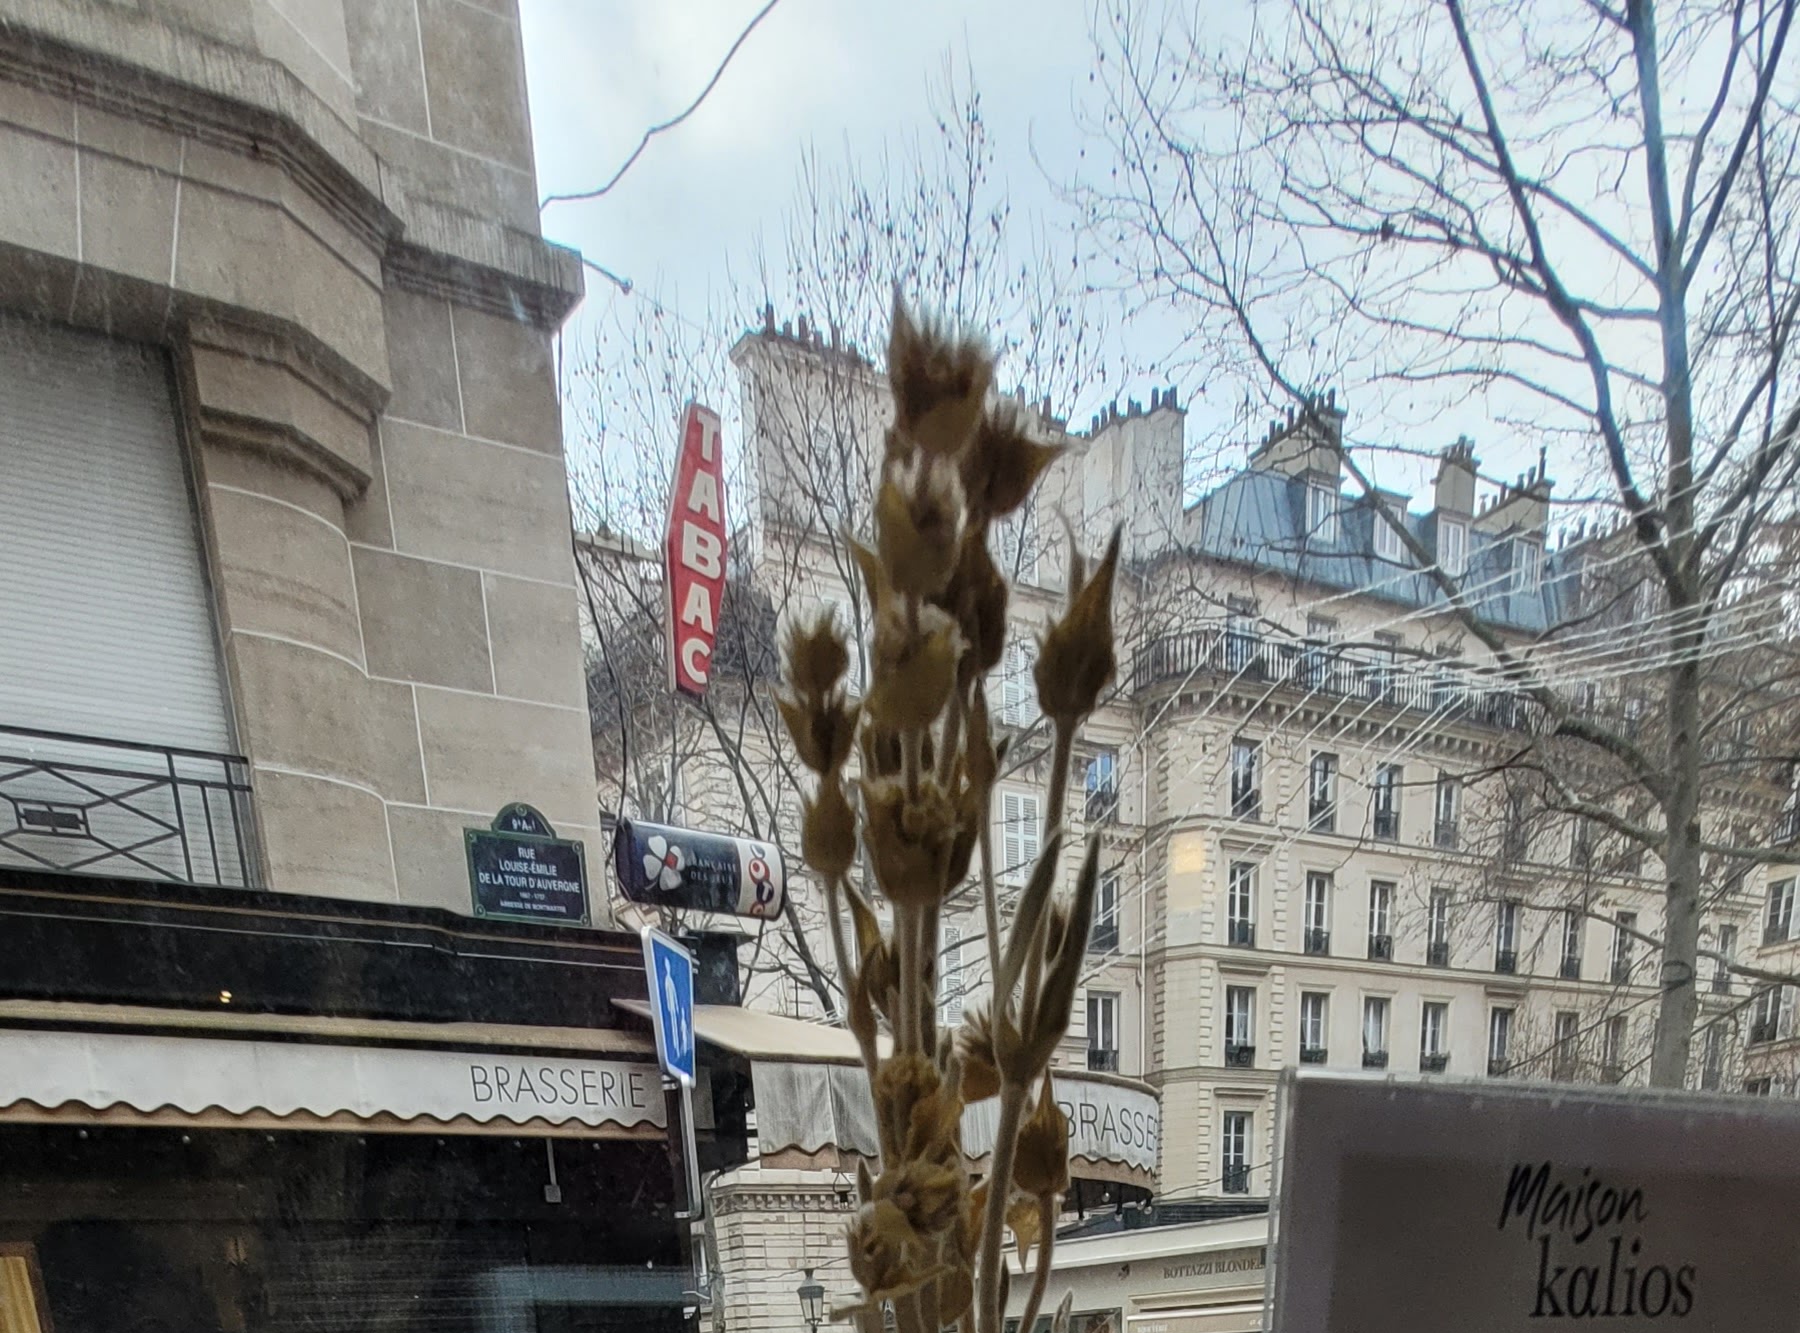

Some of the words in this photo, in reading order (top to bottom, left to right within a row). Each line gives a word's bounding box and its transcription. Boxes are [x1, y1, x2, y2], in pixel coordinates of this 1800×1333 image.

[681, 410, 722, 685] TABAC
[499, 860, 557, 876] LOUISE-ÉMILIE
[517, 847, 536, 859] RUE
[479, 872, 491, 884] DE
[491, 874, 503, 886] LA
[505, 875, 527, 888] TOUR
[529, 877, 580, 893] D'AUVERGNE
[470, 1063, 647, 1110] BRASSERIE
[1498, 1160, 1648, 1243] Maison
[1163, 1262, 1212, 1280] BOTTAZZI
[1528, 1235, 1697, 1319] kalios
